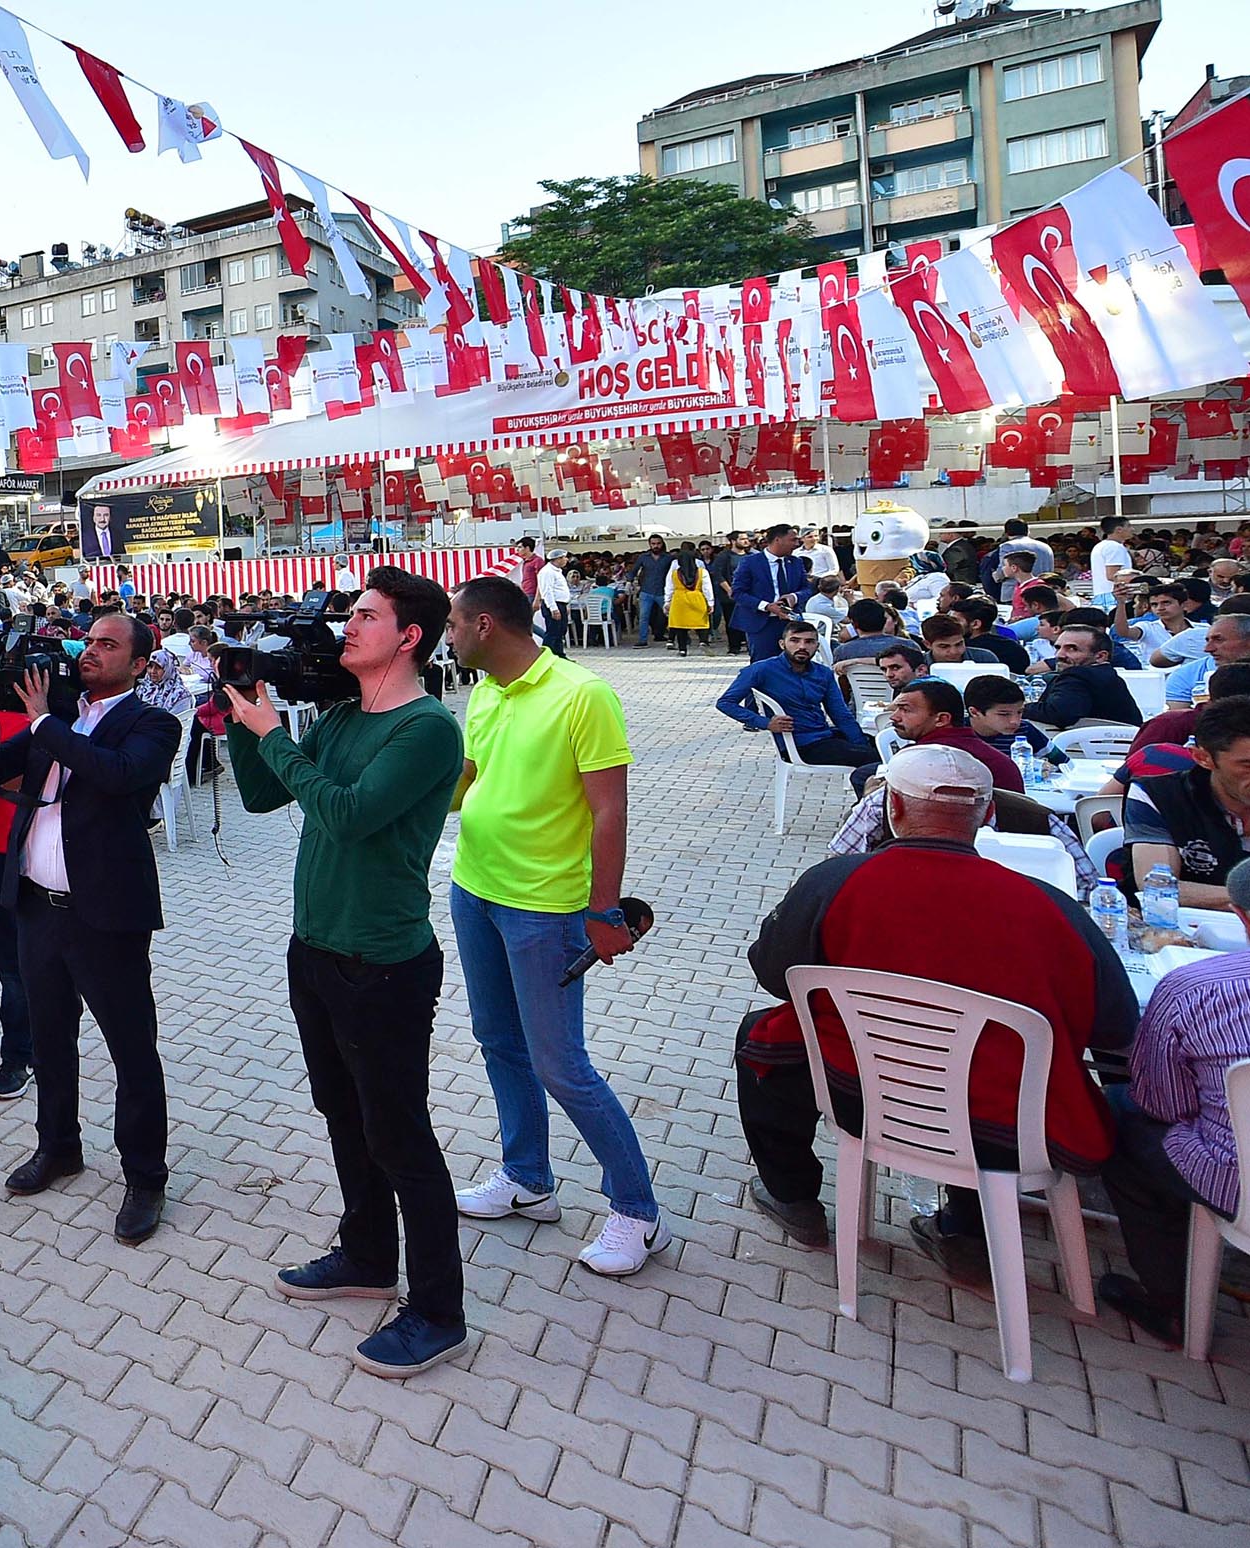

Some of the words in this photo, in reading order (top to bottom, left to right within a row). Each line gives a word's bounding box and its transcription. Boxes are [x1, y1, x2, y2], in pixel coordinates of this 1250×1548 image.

[497, 382, 526, 392] Büyükşehir
[526, 376, 554, 389] Belediyesi
[578, 362, 630, 400] HOŞ
[507, 414, 558, 429] BÜYÜKŞEHİR
[584, 403, 638, 419] BÜYÜKŞEHİR
[667, 394, 726, 408] BÜYÜKŞEHİR
[17, 480, 39, 489] MARKET
